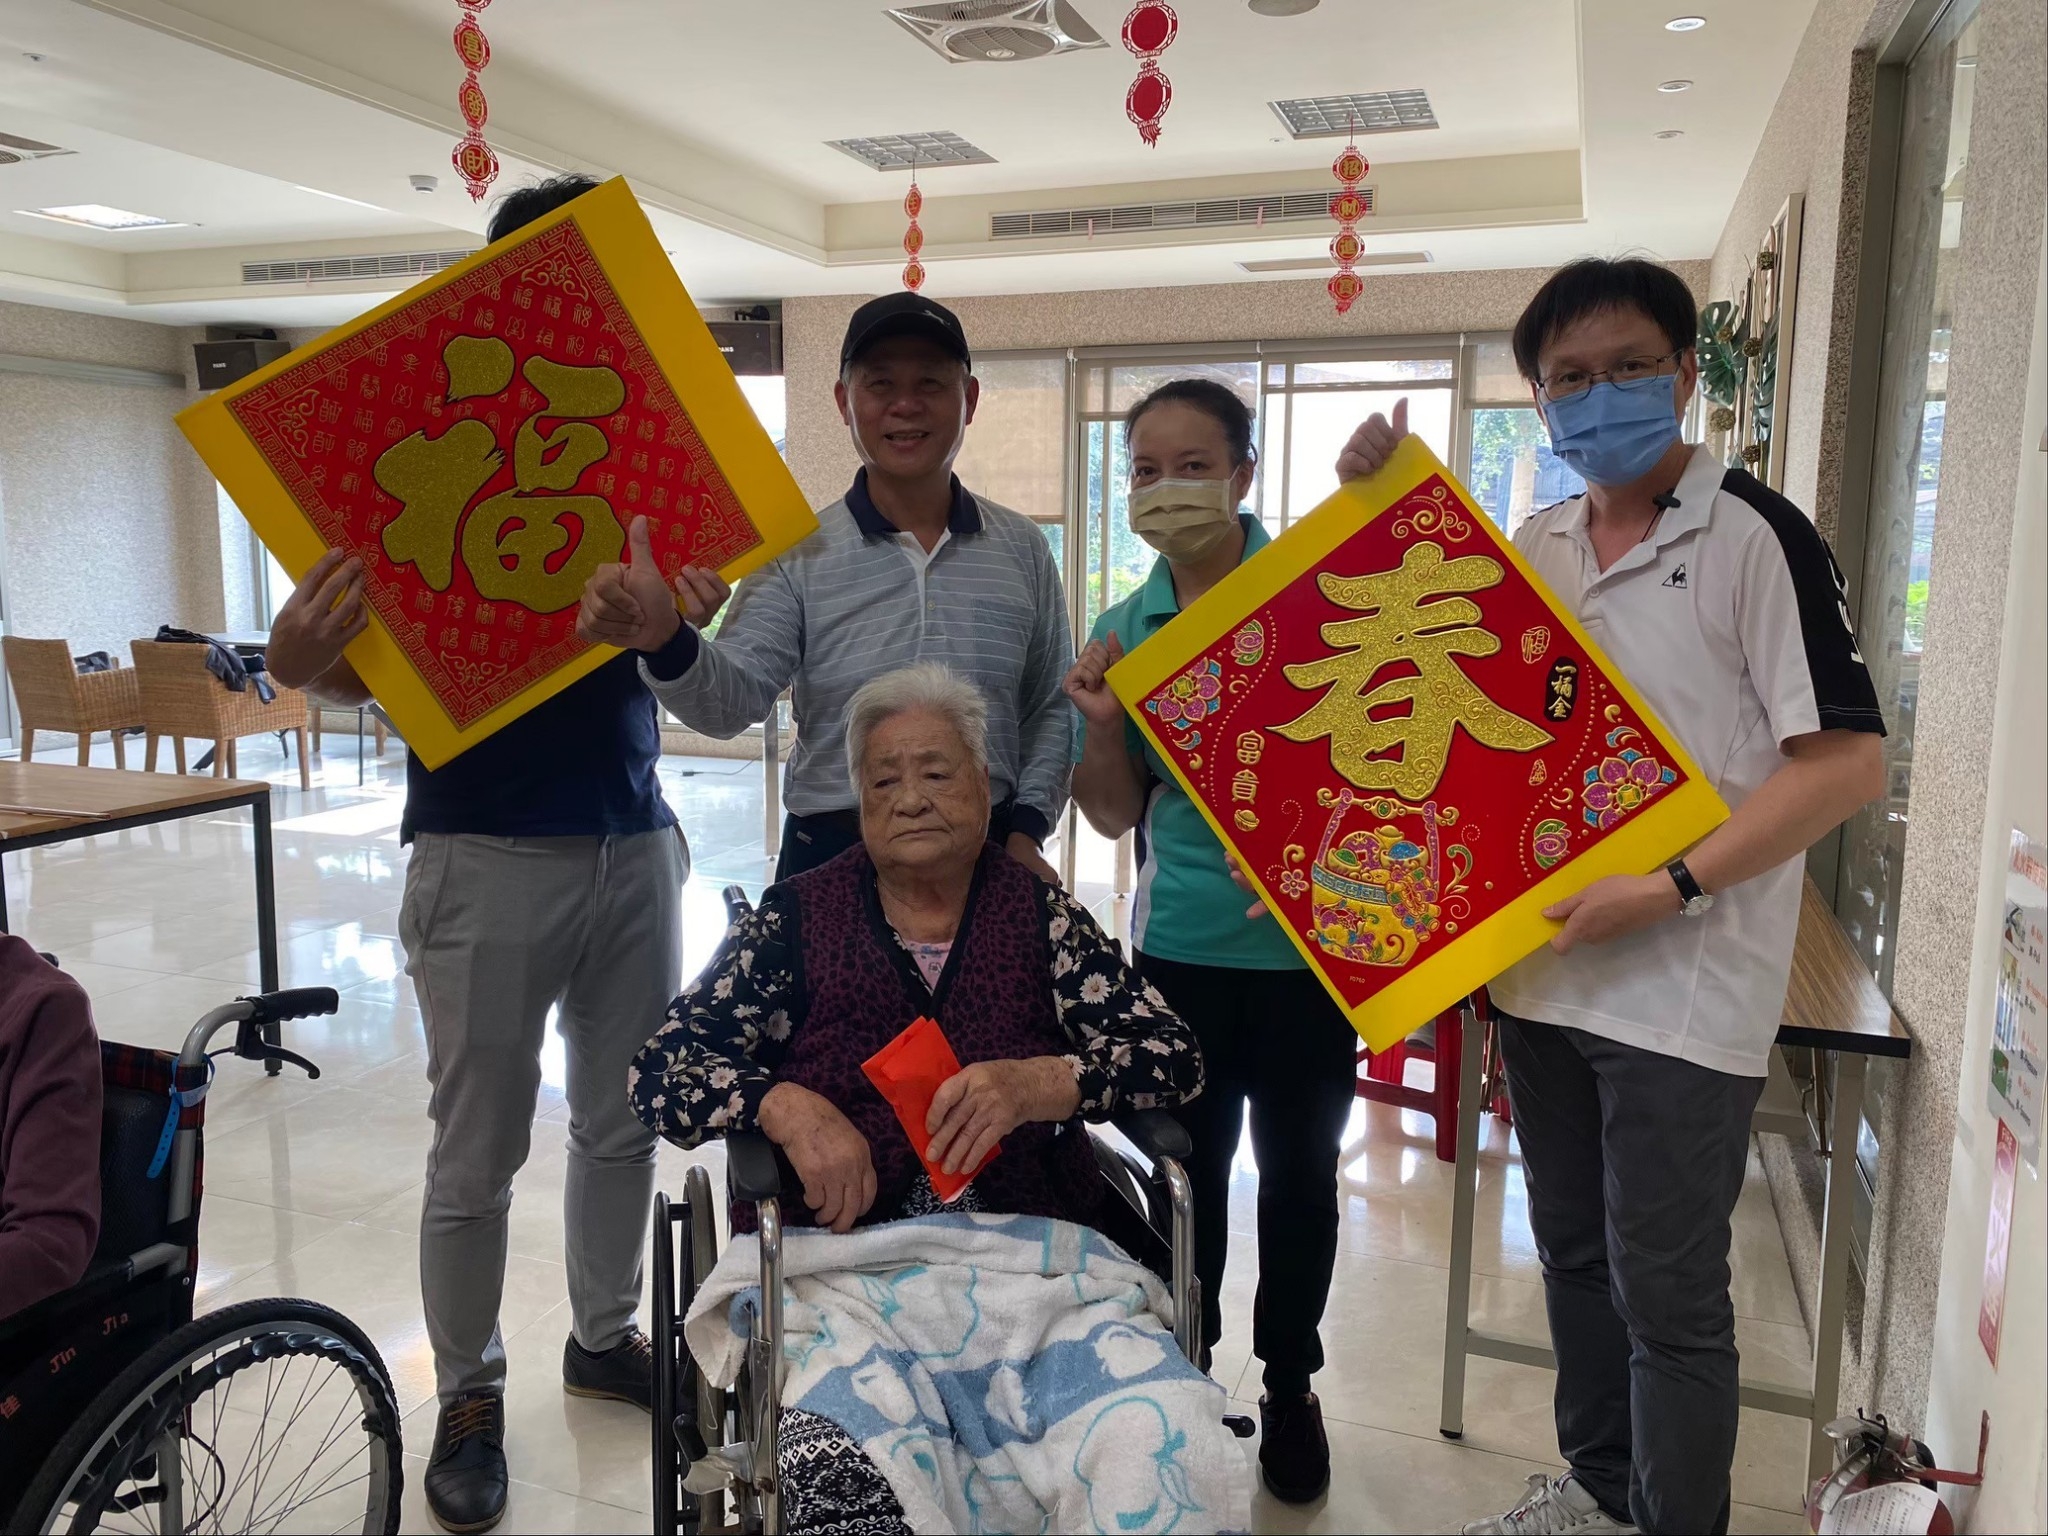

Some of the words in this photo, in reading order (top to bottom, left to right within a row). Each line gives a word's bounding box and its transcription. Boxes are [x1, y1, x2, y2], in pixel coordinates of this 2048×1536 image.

[373, 334, 627, 615] 福
[1265, 541, 1556, 801] 春
[1547, 664, 1578, 719] 一桶金
[1231, 729, 1265, 805] 富貴
[50, 1347, 77, 1374] Jin
